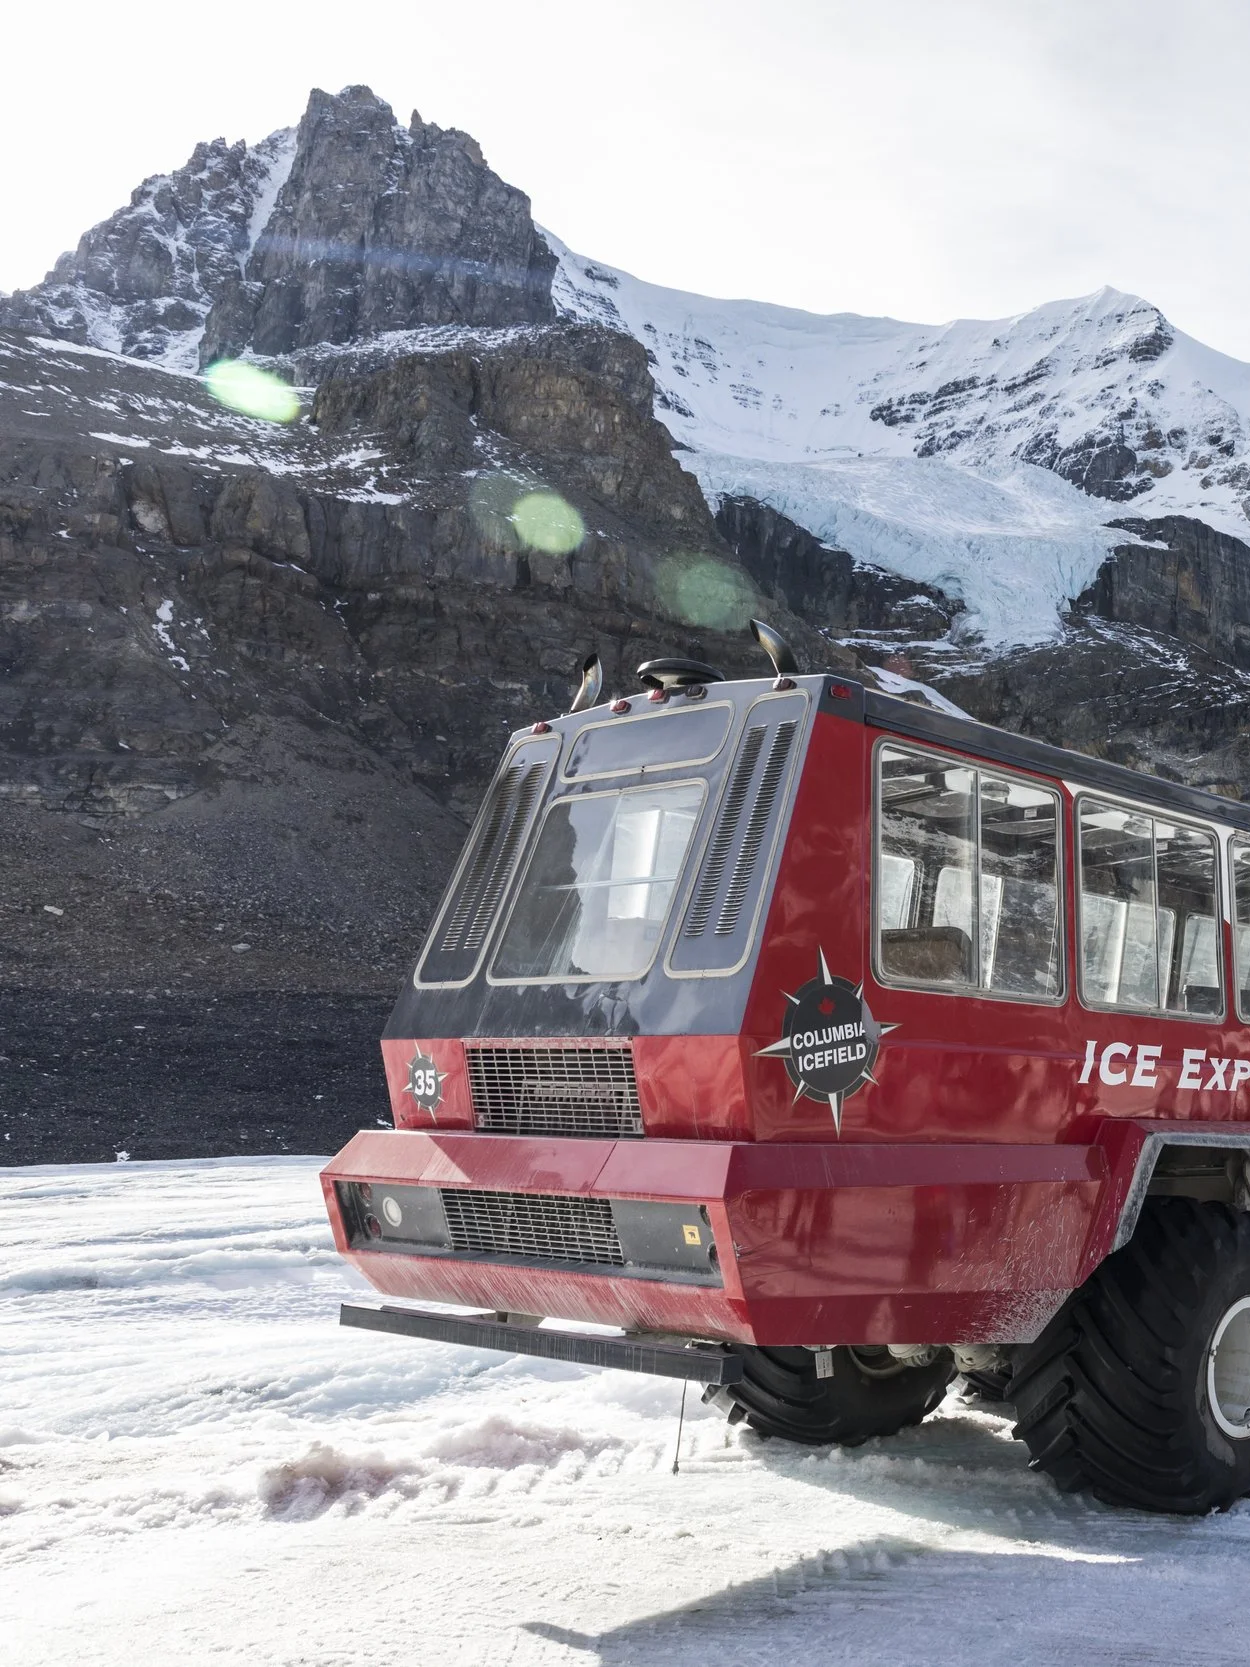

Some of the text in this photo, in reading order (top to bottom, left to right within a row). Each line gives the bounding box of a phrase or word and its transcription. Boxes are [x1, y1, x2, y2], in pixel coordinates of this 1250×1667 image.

[798, 1043, 867, 1072] ICEFIELD
[1078, 1040, 1163, 1089] ICE
[414, 1069, 436, 1096] 35
